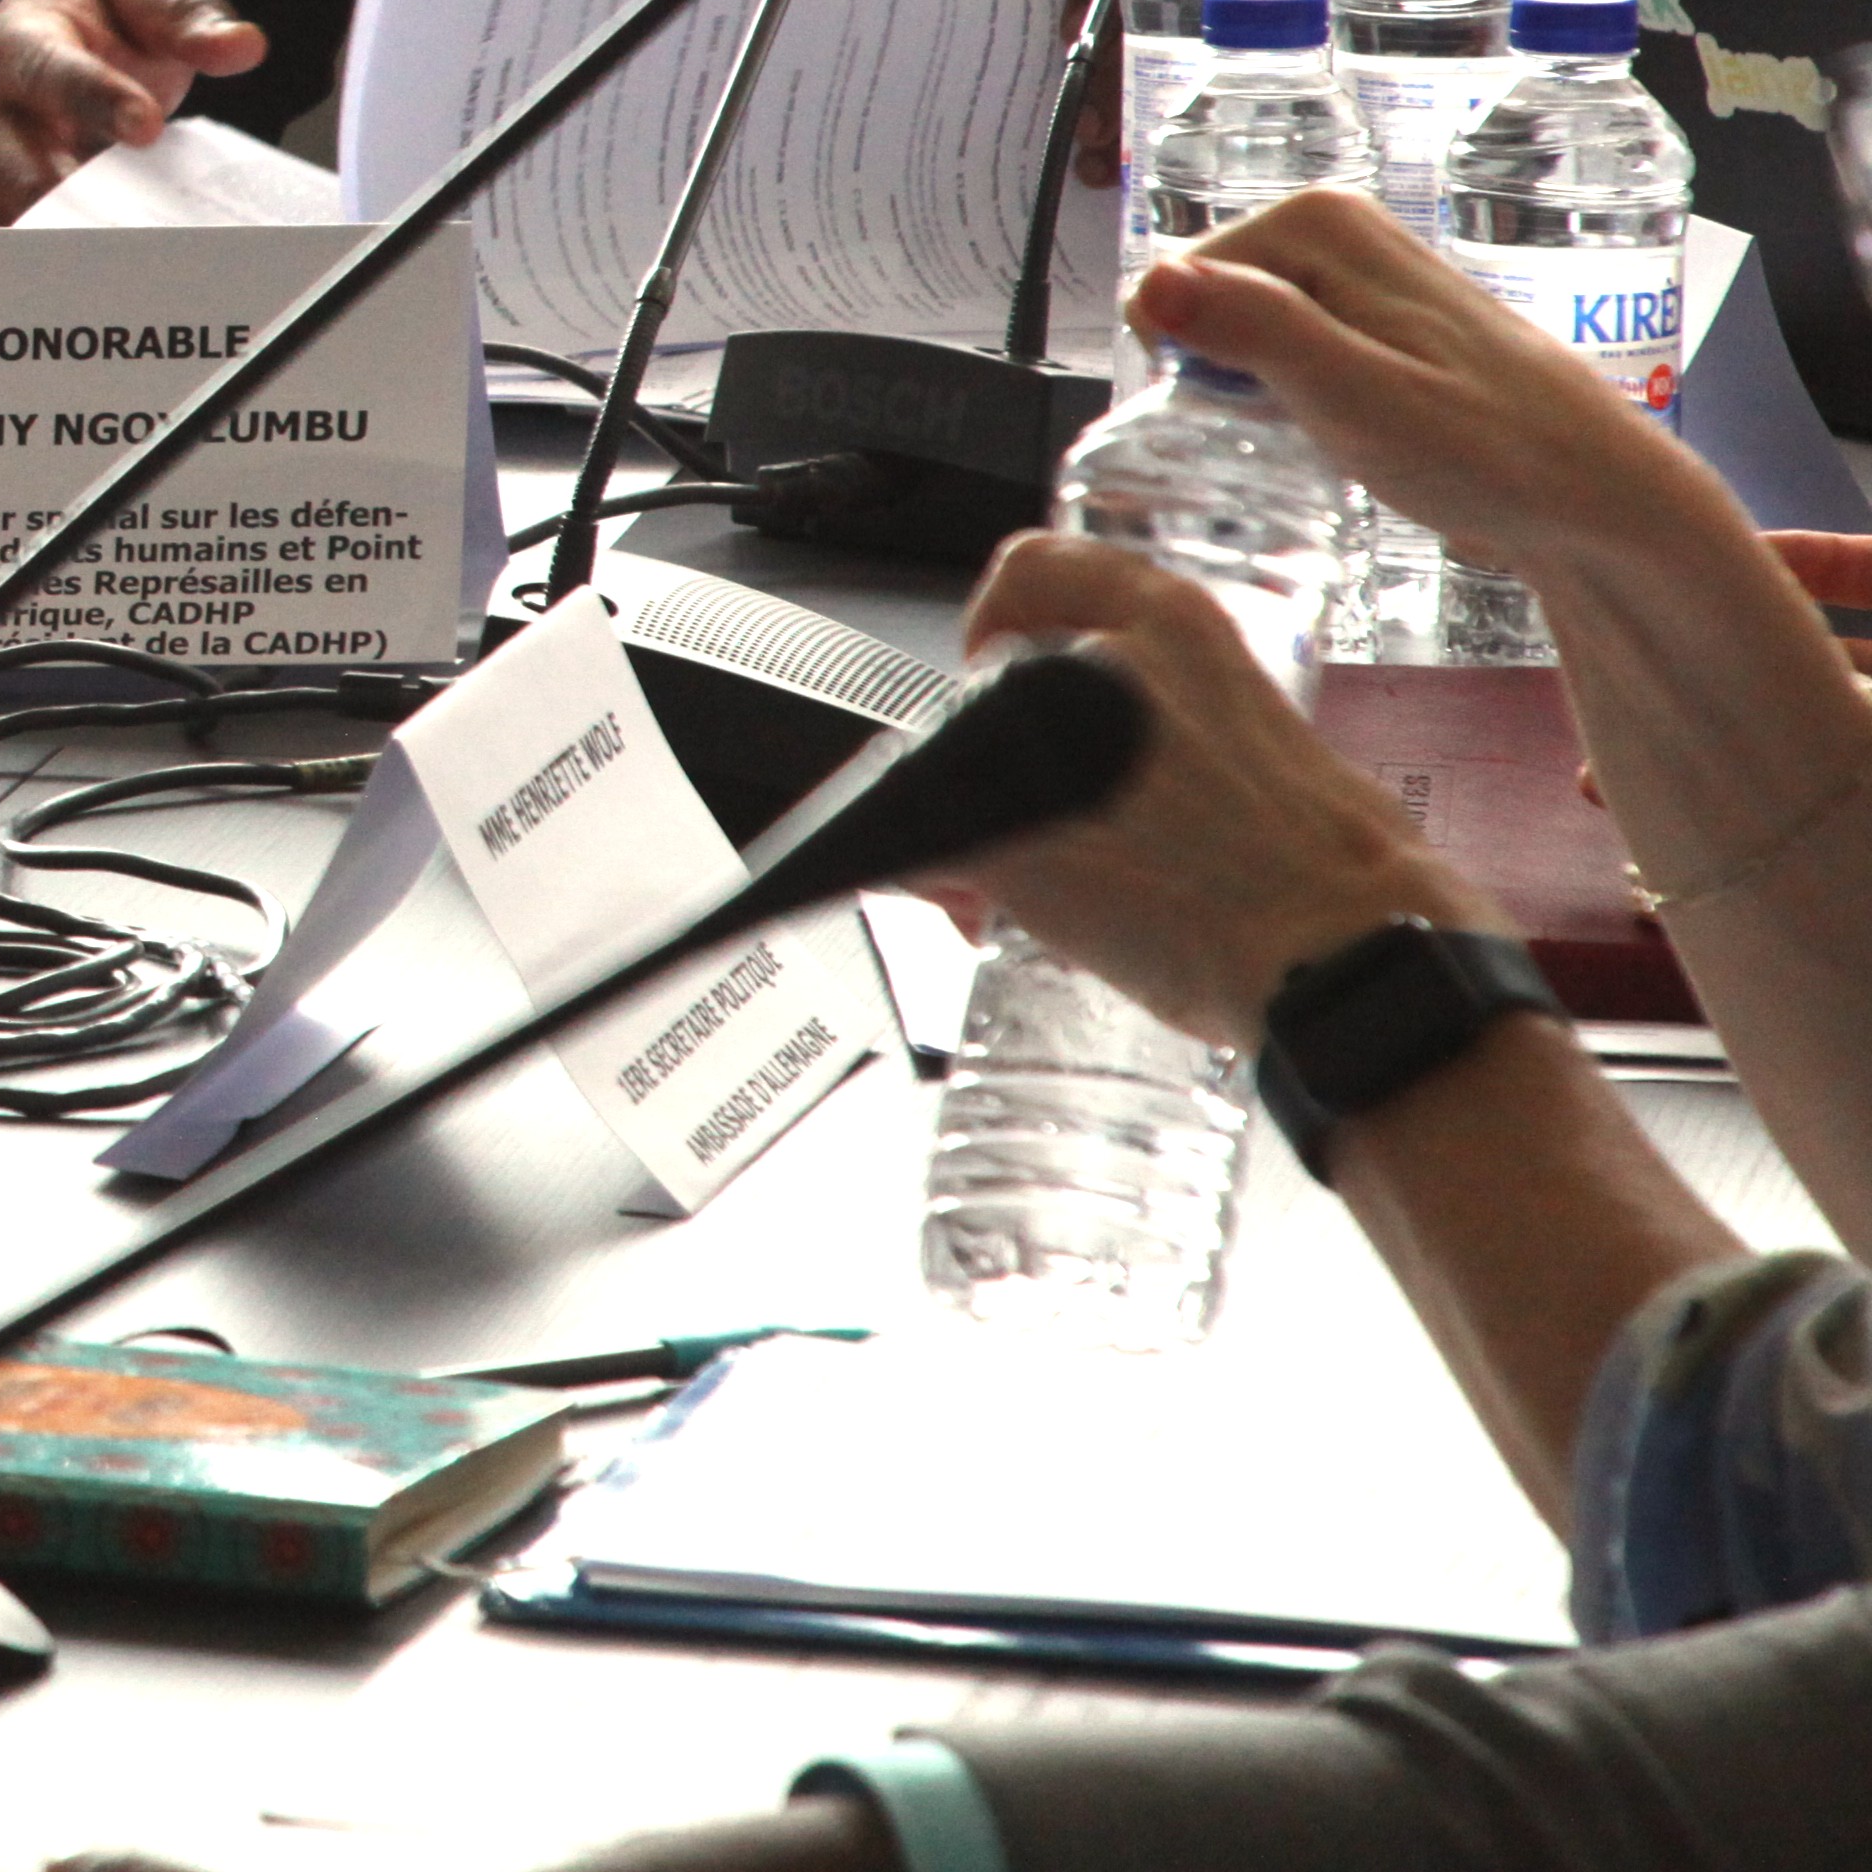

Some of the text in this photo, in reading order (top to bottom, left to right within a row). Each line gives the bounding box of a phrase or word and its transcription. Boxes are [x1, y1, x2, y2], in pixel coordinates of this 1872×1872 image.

[53, 411, 170, 446] NGO
[160, 506, 218, 530] sur
[228, 501, 278, 529] les
[290, 499, 409, 529] défen-
[114, 535, 266, 564] humains
[277, 537, 316, 562] et
[326, 533, 422, 562] Point
[94, 565, 313, 601] Représailles
[323, 571, 369, 595] en
[127, 600, 255, 629] CADHP
[144, 630, 189, 656] de
[200, 630, 233, 656] la
[244, 630, 389, 661] CADHP)
[477, 710, 627, 862] MME HENRIETTE WOLF
[1402, 773, 1432, 833] OTES
[645, 983, 726, 1080] SECRETAIRE
[709, 940, 784, 1023] POLITIQUE
[685, 1081, 767, 1168] AMBASSADE
